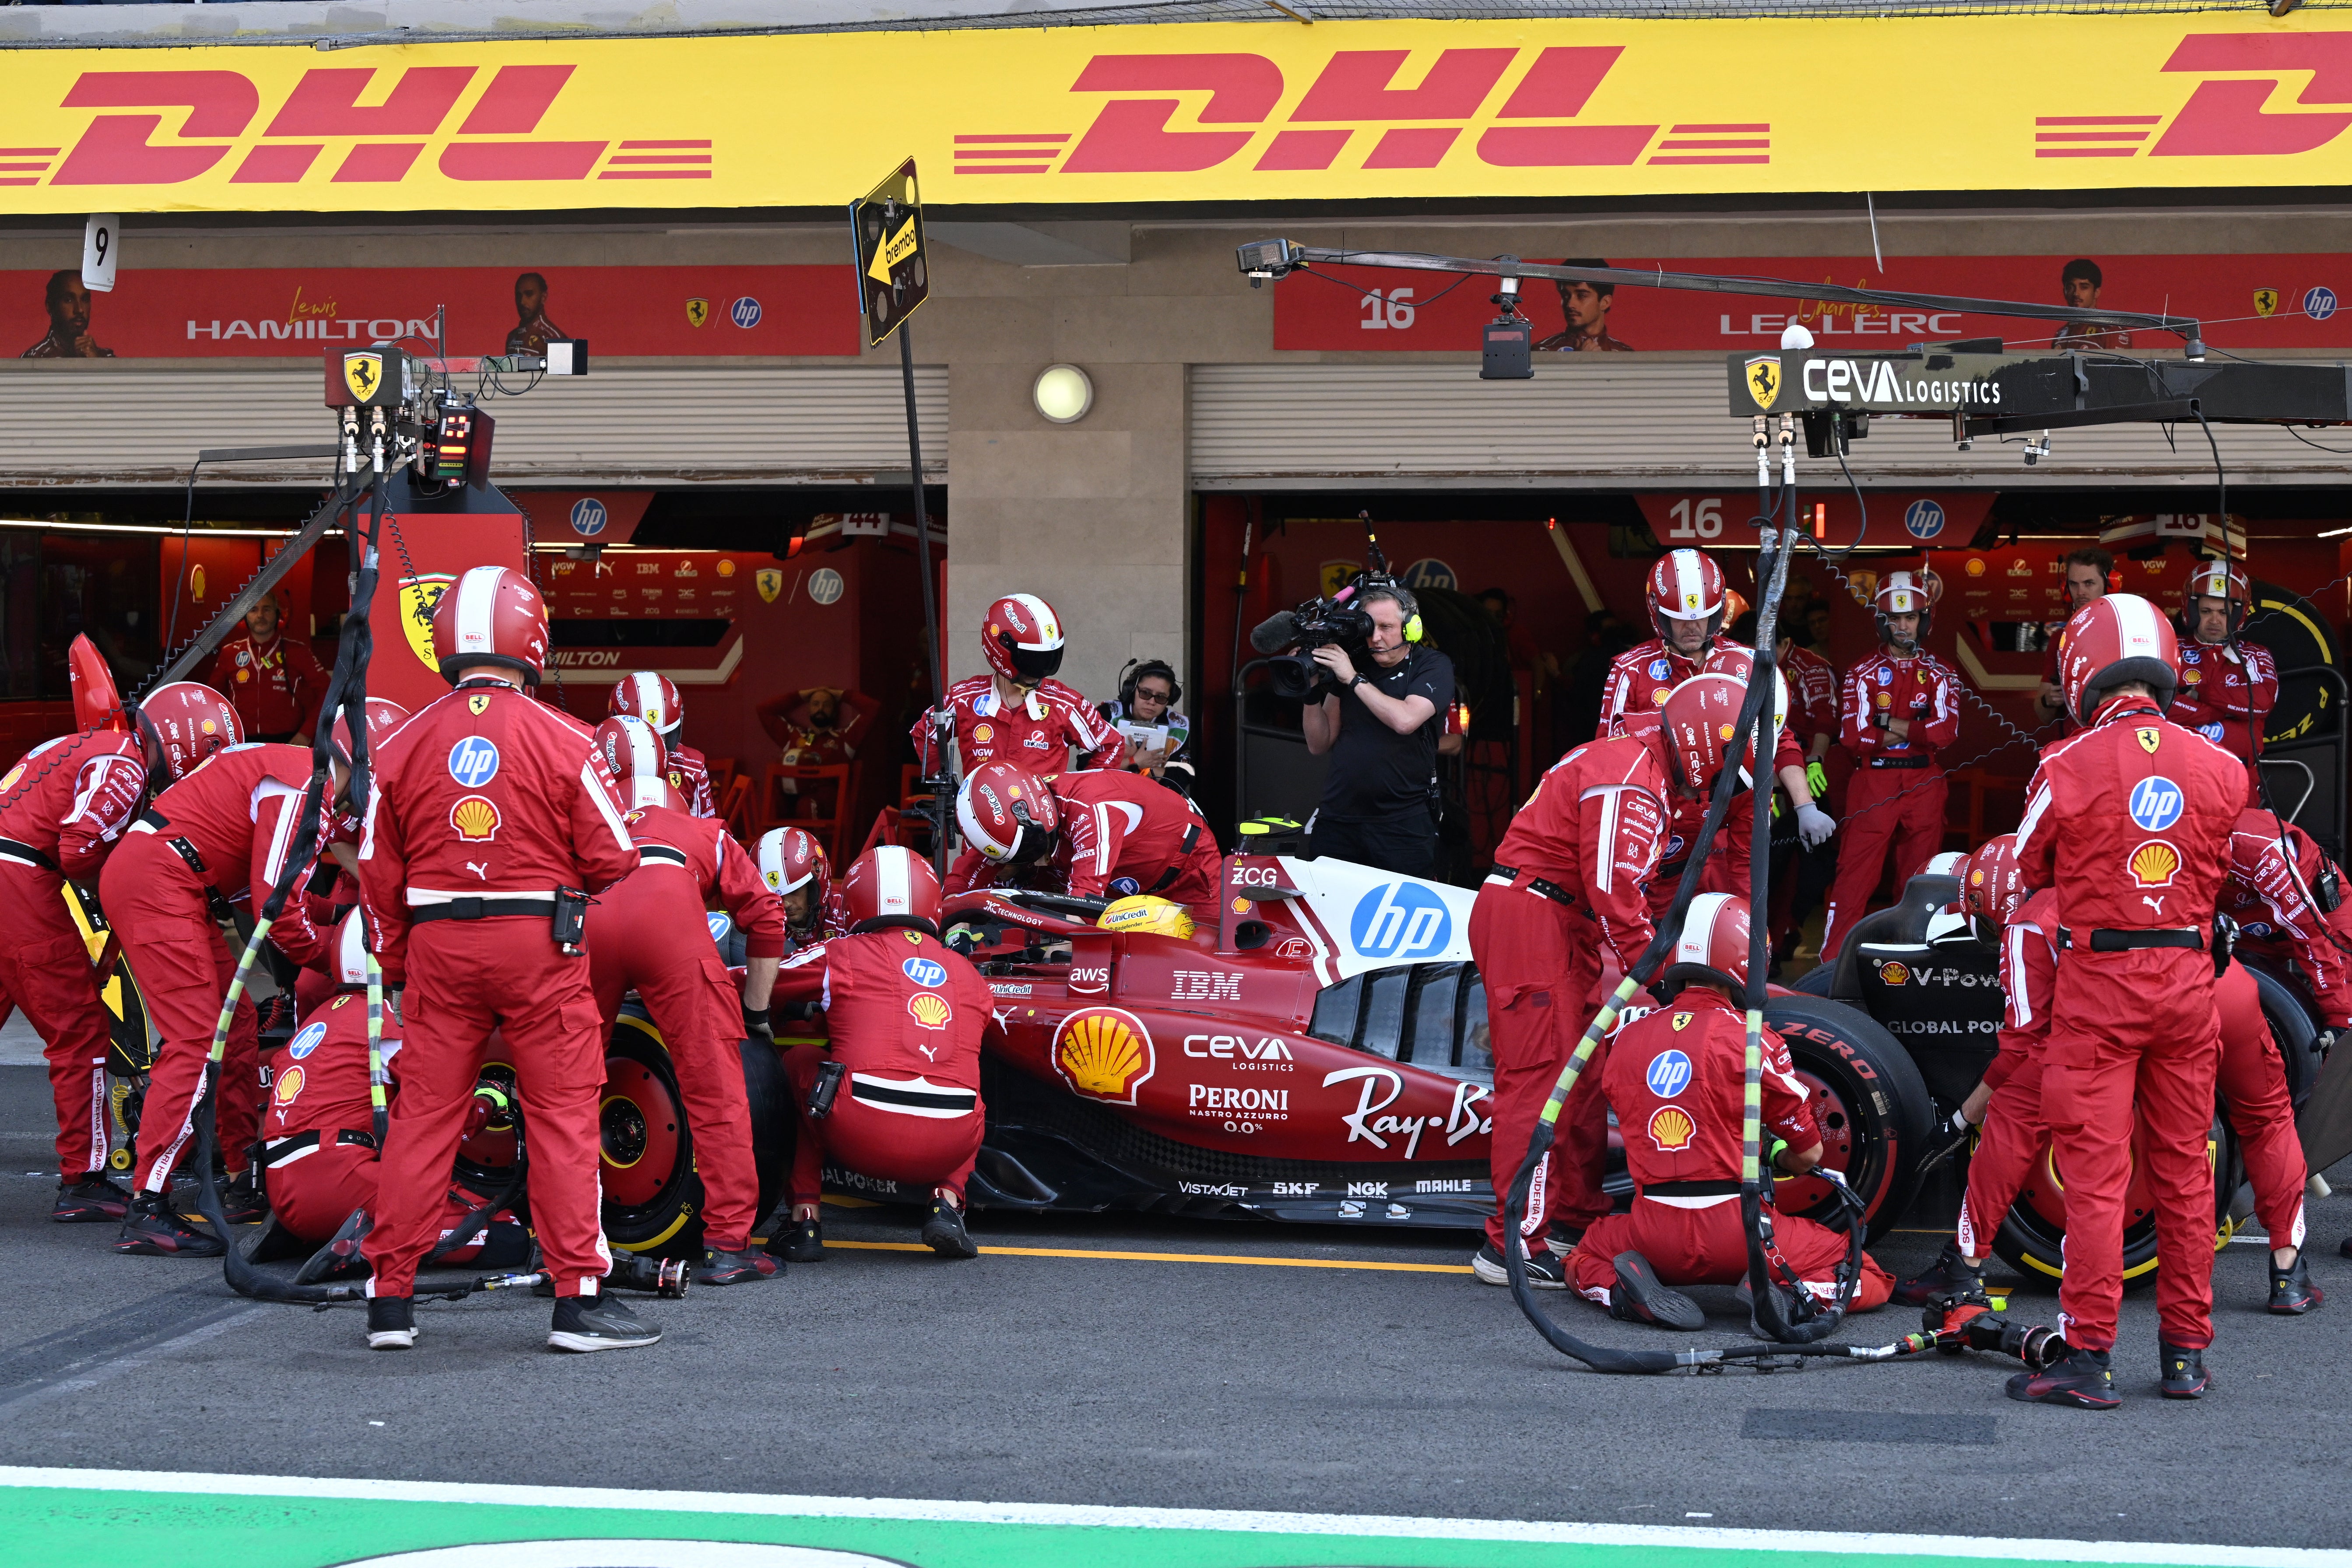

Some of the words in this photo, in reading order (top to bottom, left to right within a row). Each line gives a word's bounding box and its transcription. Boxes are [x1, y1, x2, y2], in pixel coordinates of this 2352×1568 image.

[1058, 46, 1660, 173] DHL
[48, 64, 611, 186] DHL
[95, 227, 109, 267] 9
[885, 228, 916, 265] brembo
[288, 286, 337, 325] Lewis
[1360, 288, 1415, 330] 16
[1798, 276, 1882, 323] Charles
[2306, 287, 2333, 319] hp
[734, 297, 759, 329] hp
[1720, 314, 1962, 334] LECLERC
[187, 319, 439, 340] HAMILTON
[1906, 380, 2000, 404] LOGISTICS
[574, 498, 604, 535] hp
[849, 513, 881, 528] 44
[1670, 499, 1722, 538] 16
[1909, 500, 1941, 538] hp
[2165, 514, 2200, 530] 16
[636, 564, 659, 574] IBM
[2142, 561, 2166, 569] VGW
[811, 568, 839, 604] hp
[1656, 568, 1667, 596] UniCredit
[1006, 607, 1026, 633] UniCredit
[237, 651, 249, 666] hp
[547, 652, 620, 666] MILTON
[993, 647, 1003, 658] MILLE
[1618, 652, 1632, 662] DXC
[1651, 660, 1669, 681] hp
[197, 690, 207, 704] PERONI
[617, 685, 628, 710] UniCredit
[952, 684, 966, 692] DXC
[1057, 690, 1078, 700] TECHNOLOGY
[2175, 701, 2197, 712] RICHARD
[2227, 704, 2249, 712] RICHAR
[222, 712, 237, 746] UniCredi
[1703, 722, 1712, 747] RICHARD
[972, 749, 993, 757] VGW
[1025, 740, 1048, 749] UniCredit
[453, 736, 495, 788] hp
[608, 740, 620, 773] UniCredit
[990, 767, 1004, 777] PERONI
[110, 778, 134, 803] Bitdefender
[1022, 779, 1031, 792] MILLE
[982, 785, 1003, 815] UniCredit
[1029, 793, 1039, 813] RICHARD
[2134, 776, 2180, 831] hp
[1624, 817, 1654, 835] Bitdefender
[799, 831, 807, 856] UniCredit
[1996, 844, 2005, 861] ambipar
[2264, 868, 2288, 892] Bitdefender
[984, 900, 1000, 914] DXC
[998, 908, 1043, 926] TECHNOLOGY
[1112, 909, 1148, 923] UniCredit
[1355, 882, 1447, 958] hp
[374, 917, 384, 952] RICHARD
[1115, 922, 1143, 931] Bitdefender
[1600, 916, 1617, 947] RICHARD
[1735, 924, 1750, 939] ambipa
[271, 940, 289, 954] MILLE
[907, 957, 944, 987] hp
[1070, 968, 1108, 982] aws
[1728, 968, 1744, 984] BRENDAS
[1911, 968, 2000, 987] V-Pow
[2316, 969, 2327, 989] MILLE
[994, 984, 1032, 995] UniCredit
[1171, 971, 1244, 1000] IBM
[1889, 1021, 1962, 1034] GLOBAL
[1969, 1021, 2005, 1034] POK
[293, 1023, 324, 1059] hp
[1779, 1022, 1878, 1079] ZERO
[1233, 1063, 1293, 1072] LOGISTICS
[1650, 1050, 1689, 1098] hp
[95, 1077, 103, 1130] SCUDERIA
[1190, 1084, 1288, 1110] PERONI
[1190, 1110, 1233, 1119] NASTRO
[1236, 1112, 1288, 1120] AZZURRO
[1322, 1067, 1492, 1159] Ray-Ba
[1224, 1121, 1263, 1134] 0.0%
[94, 1131, 104, 1172] FERRARI
[163, 1126, 192, 1165] FERRARI
[155, 1165, 165, 1181] HP
[845, 1171, 896, 1194] POKER
[1272, 1182, 1320, 1195] SKF
[1348, 1182, 1388, 1196] NGK
[1416, 1179, 1471, 1193] MAHLE
[1532, 1160, 1544, 1215] SCUDERIA
